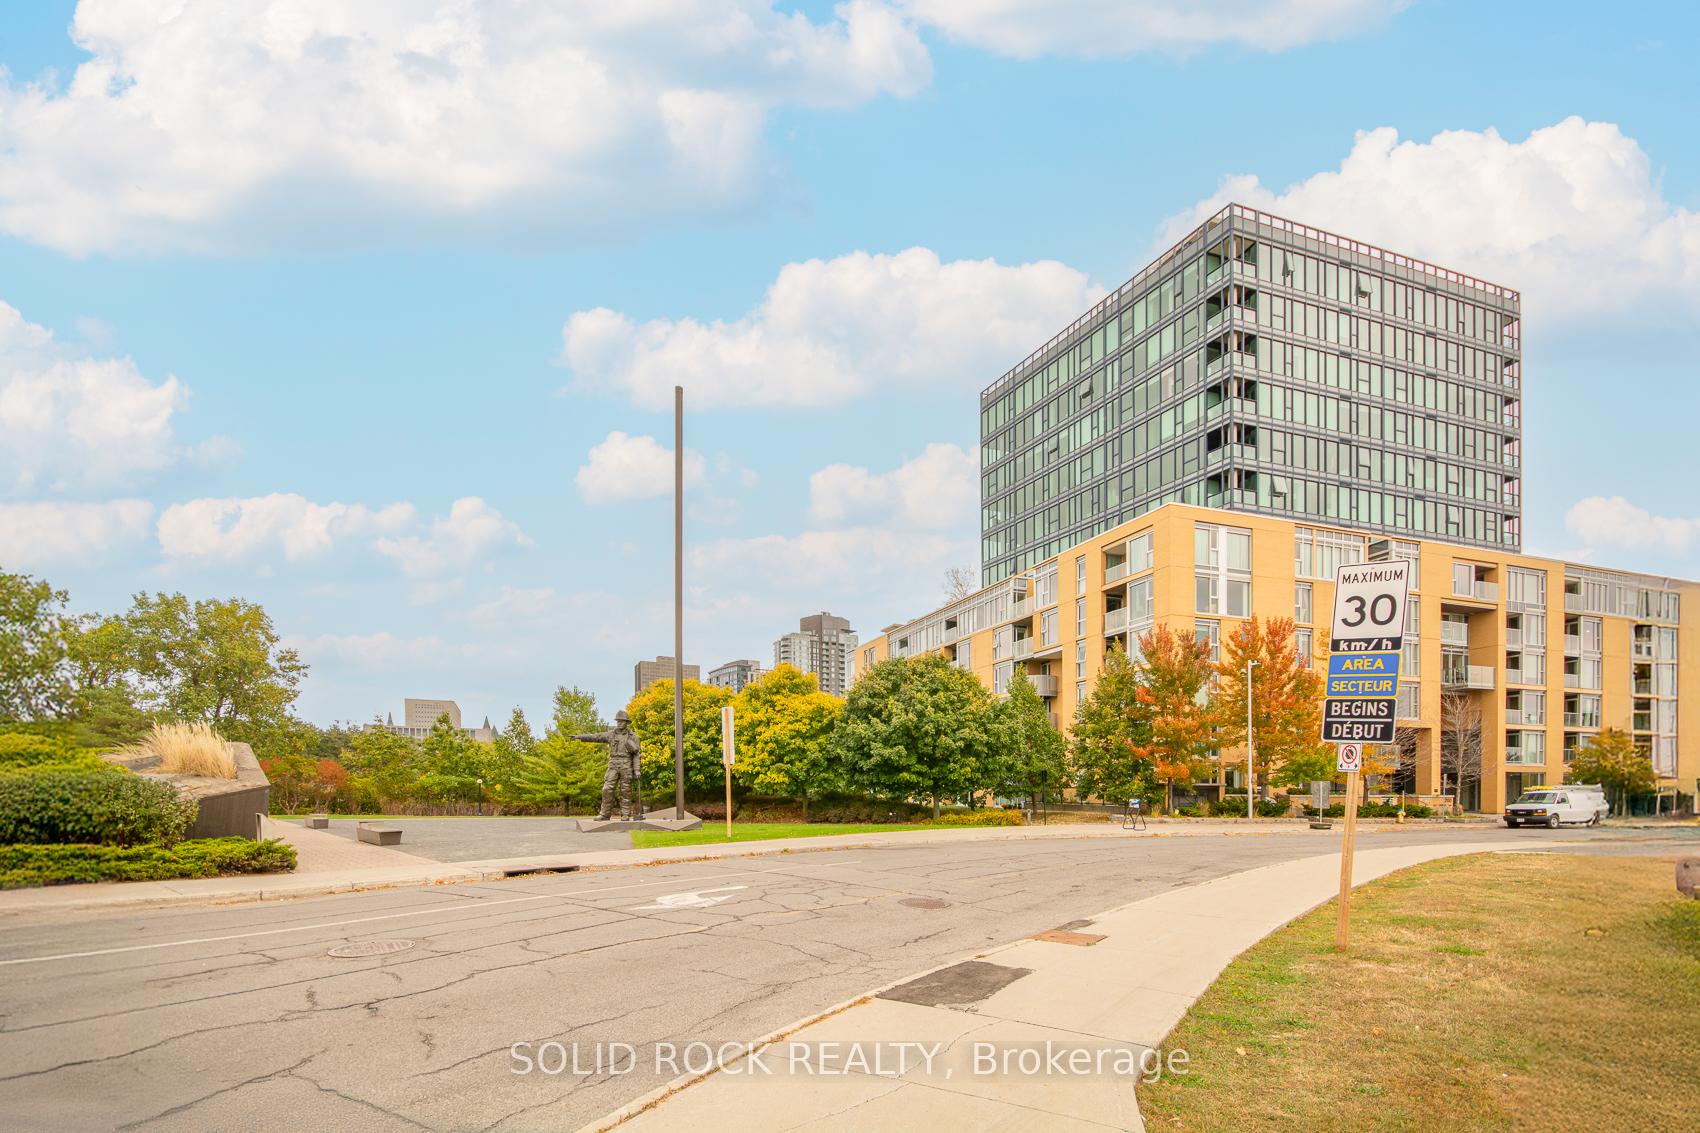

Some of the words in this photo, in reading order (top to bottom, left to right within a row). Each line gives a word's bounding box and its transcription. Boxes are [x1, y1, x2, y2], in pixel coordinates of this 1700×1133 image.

[1341, 569, 1404, 585] MAXIMUM
[1340, 593, 1397, 628] 30
[1339, 638, 1393, 651] km/h
[1341, 658, 1385, 671] AREA
[1331, 680, 1393, 692] SECTEUR
[1330, 701, 1389, 716] BEGINS
[1331, 721, 1385, 739] DÉBUT
